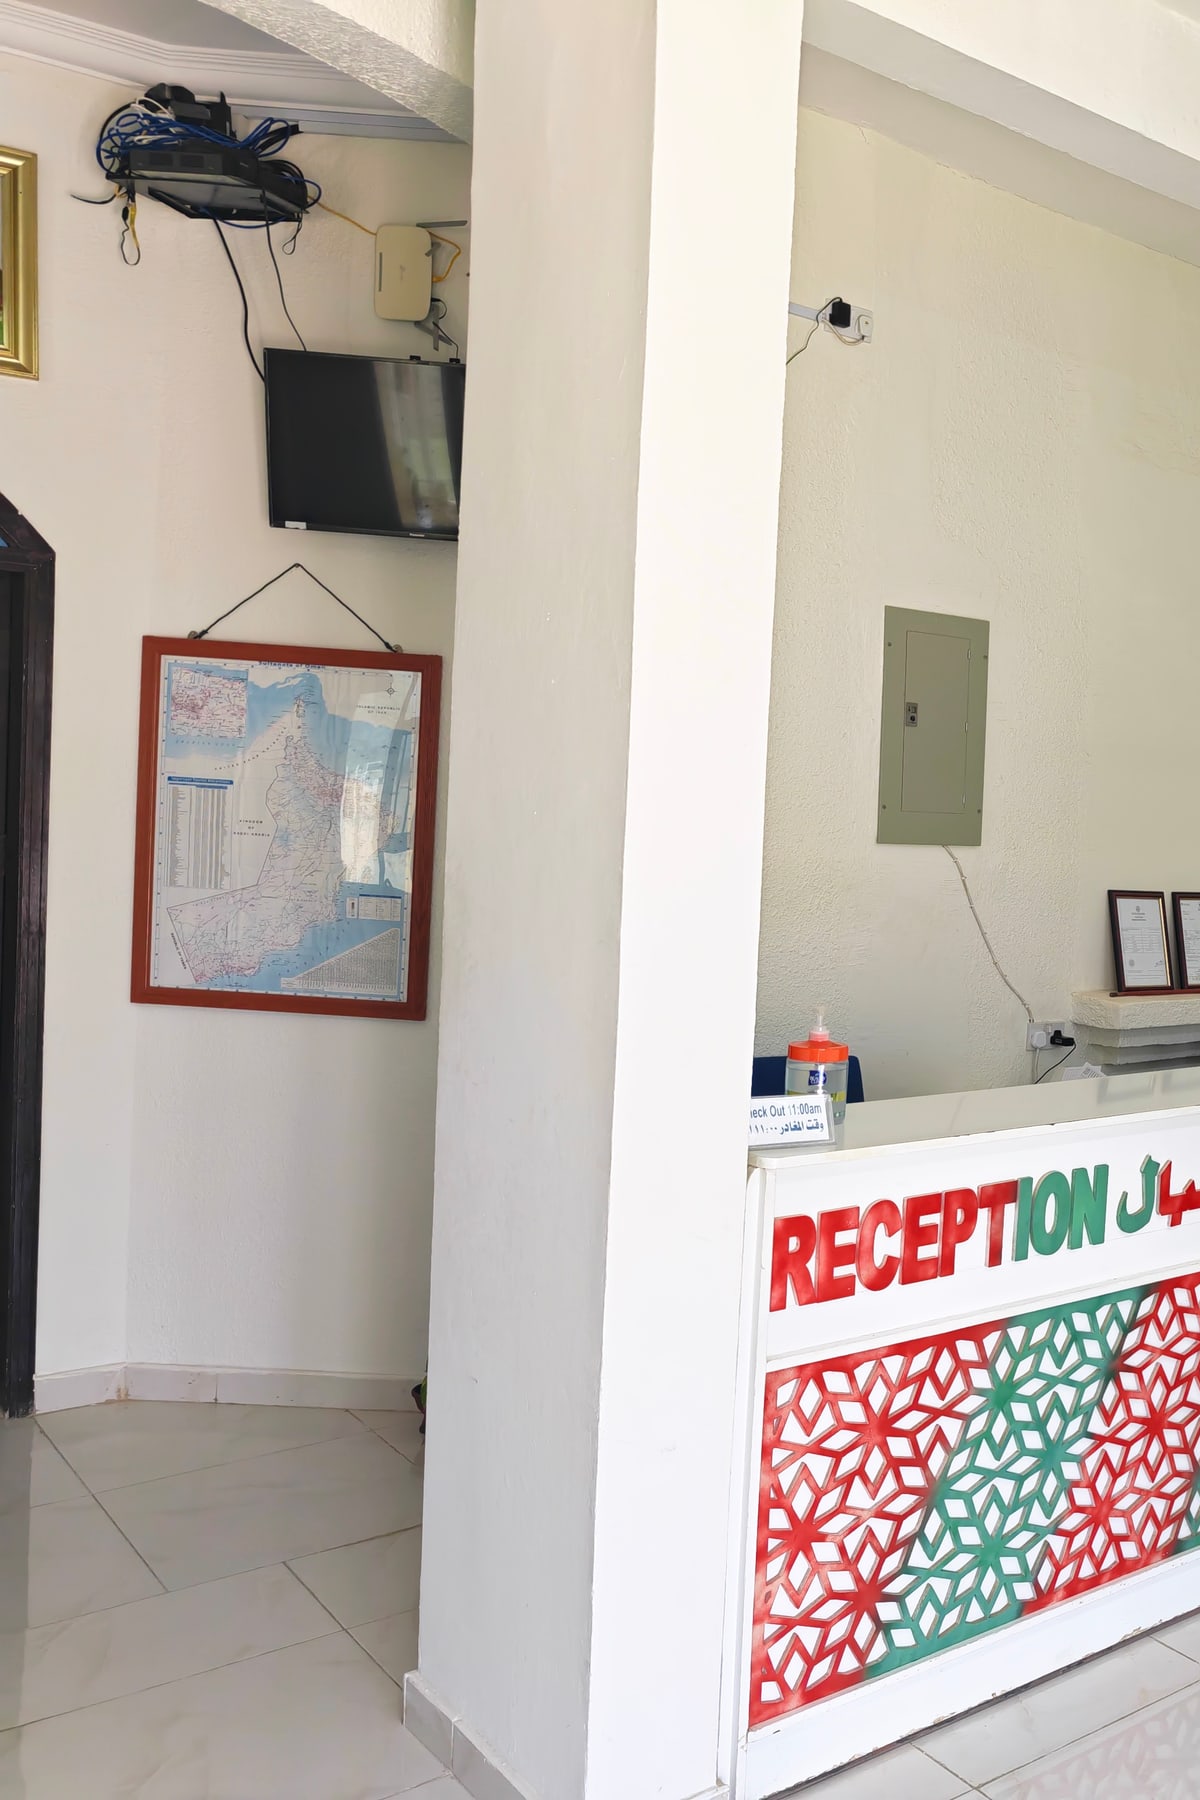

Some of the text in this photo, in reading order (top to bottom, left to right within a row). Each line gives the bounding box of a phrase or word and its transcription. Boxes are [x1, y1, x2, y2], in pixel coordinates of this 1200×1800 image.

[750, 1102, 822, 1119] eck Out 11:00am
[806, 1118, 824, 1133] وقت
[769, 1164, 1109, 1313] RECEPTION
